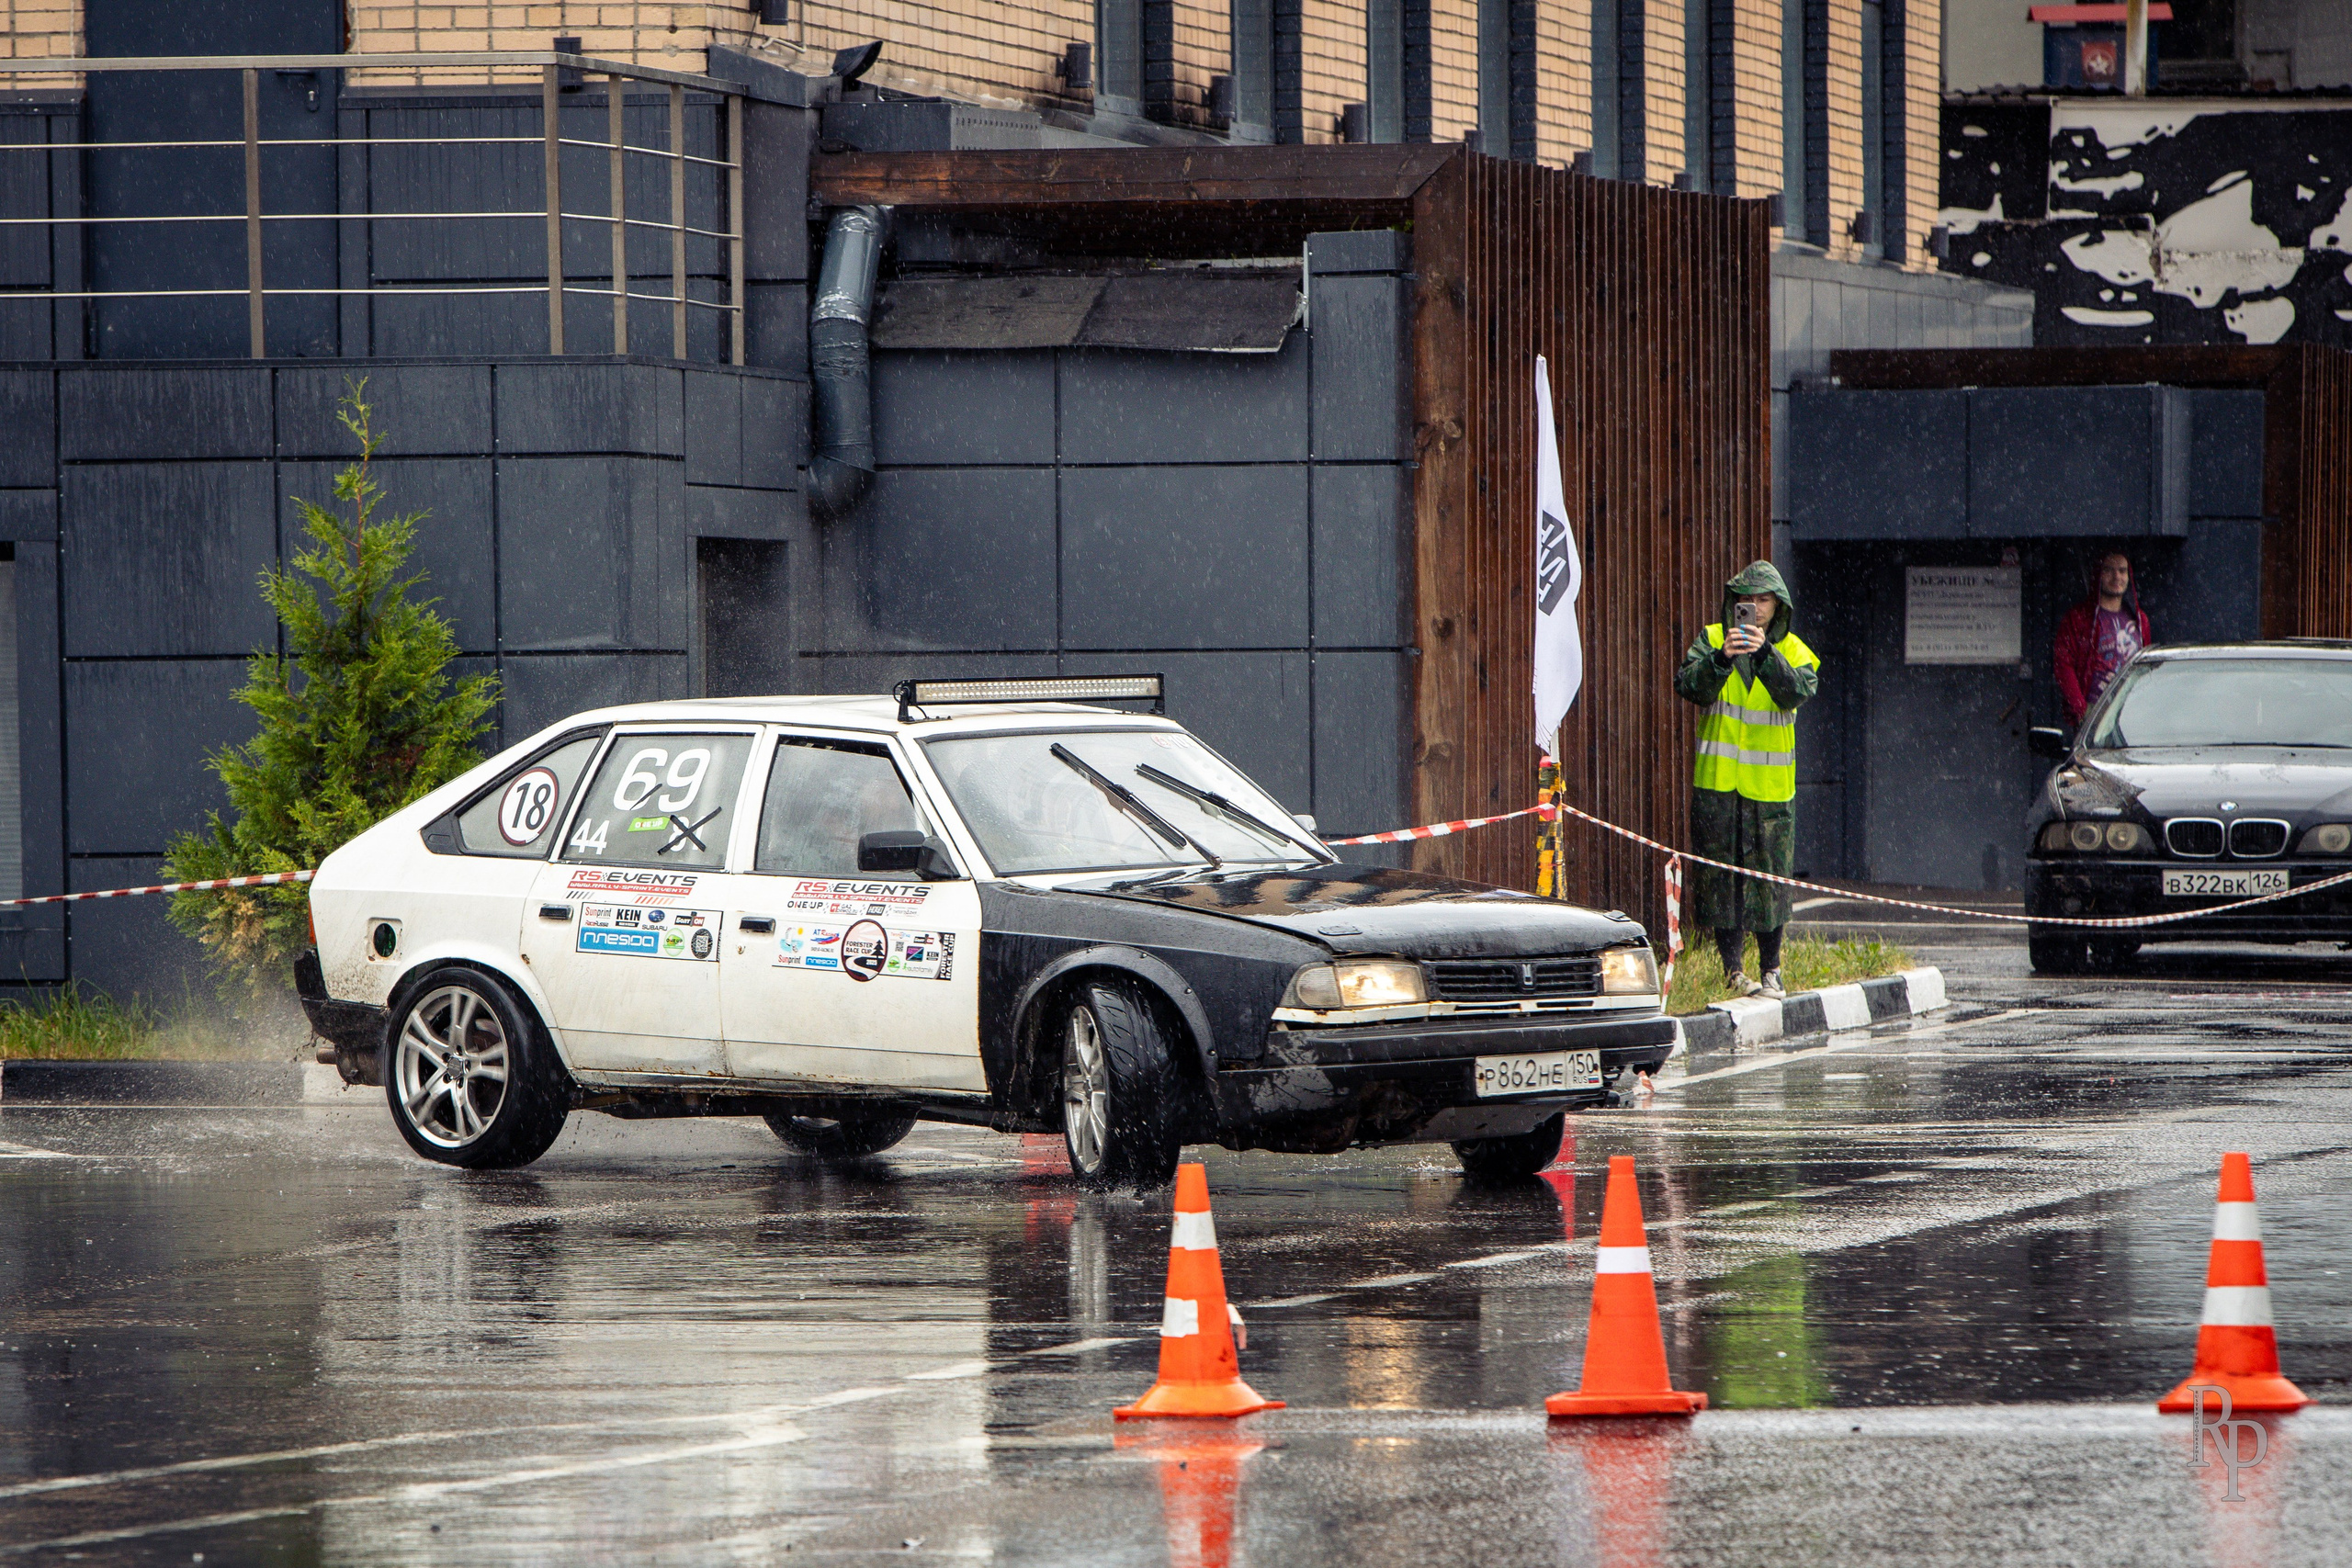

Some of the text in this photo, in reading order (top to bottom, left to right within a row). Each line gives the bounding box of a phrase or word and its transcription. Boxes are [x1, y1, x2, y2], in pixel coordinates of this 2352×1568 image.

[613, 748, 711, 812] 69
[512, 782, 551, 830] 18
[570, 818, 610, 855] 44
[571, 870, 698, 886] RS EVENTS
[2253, 874, 2282, 888] 126
[796, 881, 932, 897] RS EVENTS
[585, 907, 611, 918] Sunprint
[787, 900, 823, 909] ONE UP
[616, 908, 641, 921] KEIN
[1568, 1053, 1595, 1074] 150
[1573, 1076, 1588, 1084] RUS
